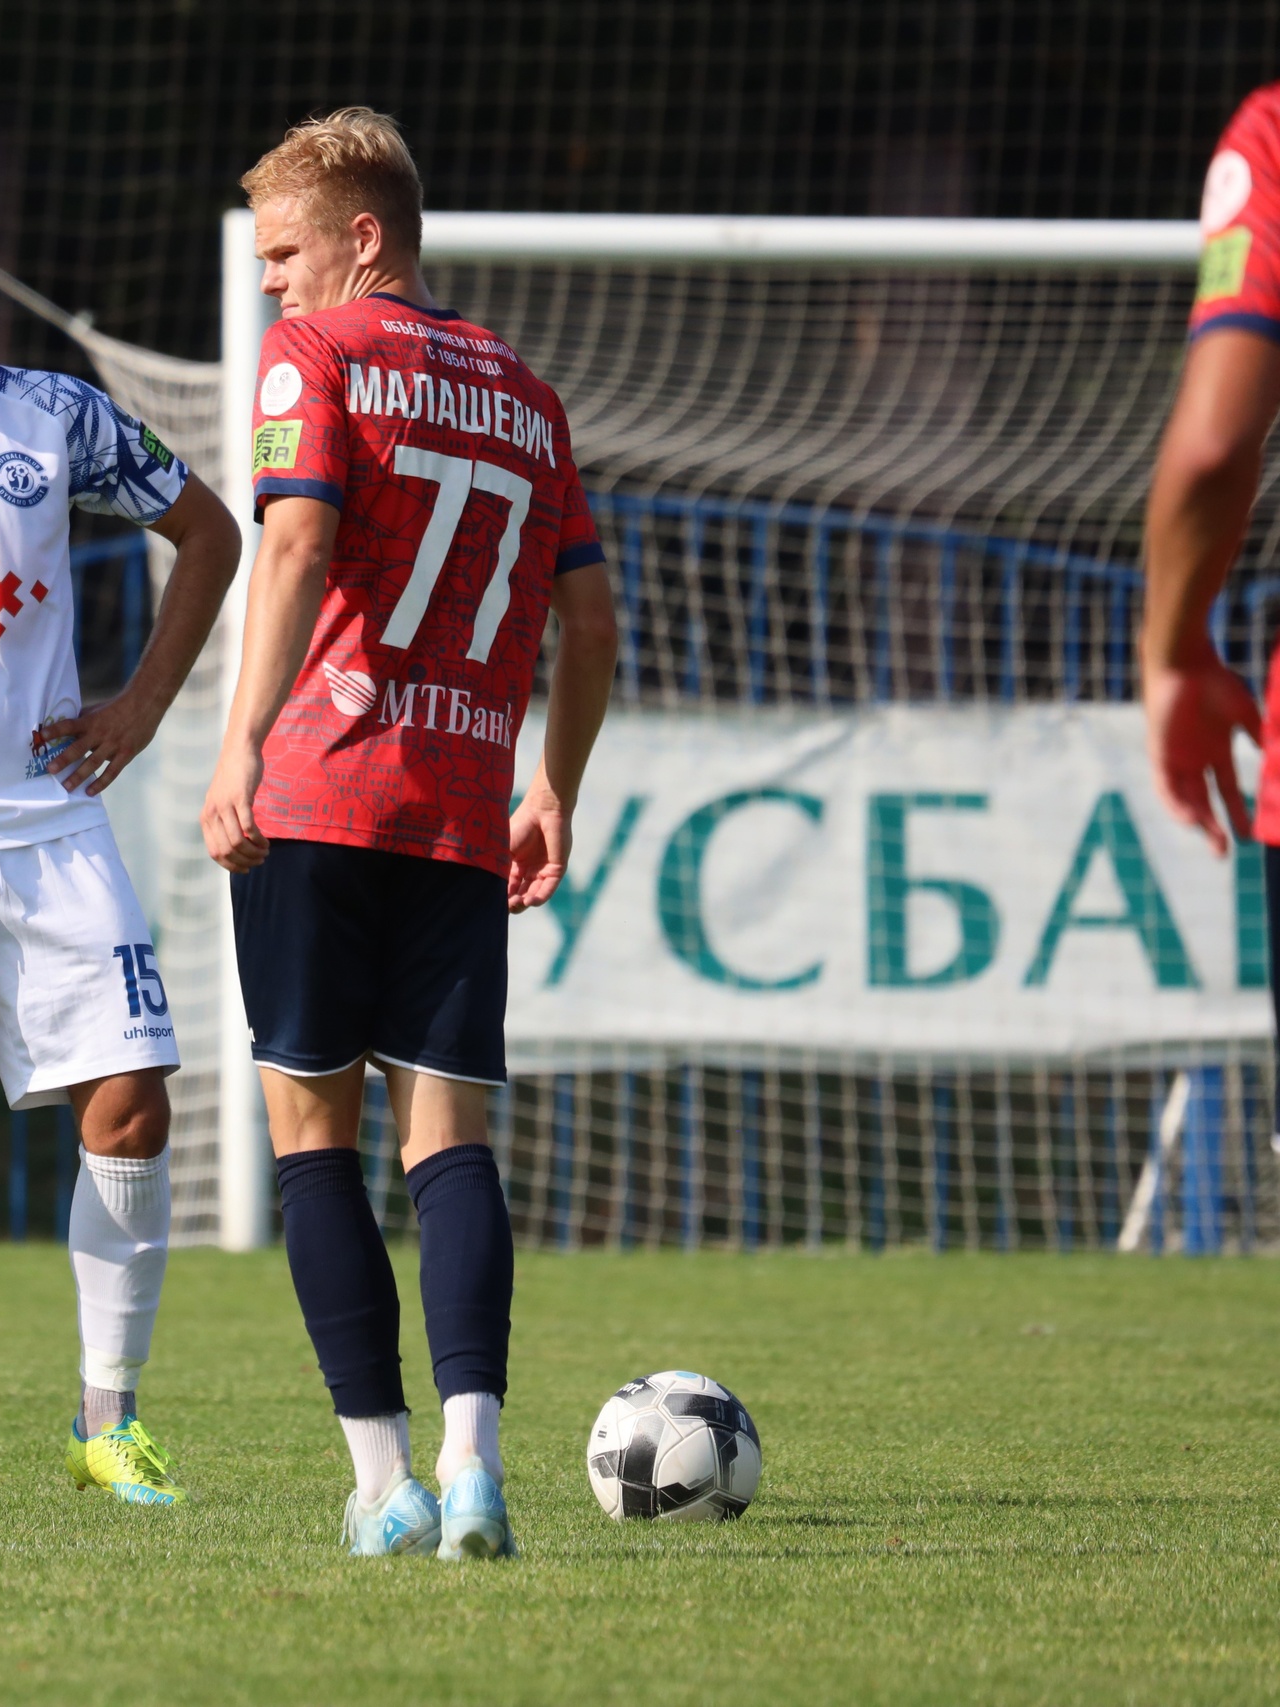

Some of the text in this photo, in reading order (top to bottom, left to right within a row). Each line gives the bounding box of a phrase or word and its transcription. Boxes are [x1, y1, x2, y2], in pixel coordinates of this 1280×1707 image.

[380, 319, 519, 364] ОБЪЕДИНЯЕМ ТАЛАНТЫ
[425, 344, 505, 377] С 1954 ГОДА
[348, 362, 556, 469] МАЛАШЕВИЧ
[24, 456, 41, 471] CLUB
[0, 489, 27, 506] DYNAMO
[379, 444, 533, 665] 77
[113, 943, 169, 1018] 15
